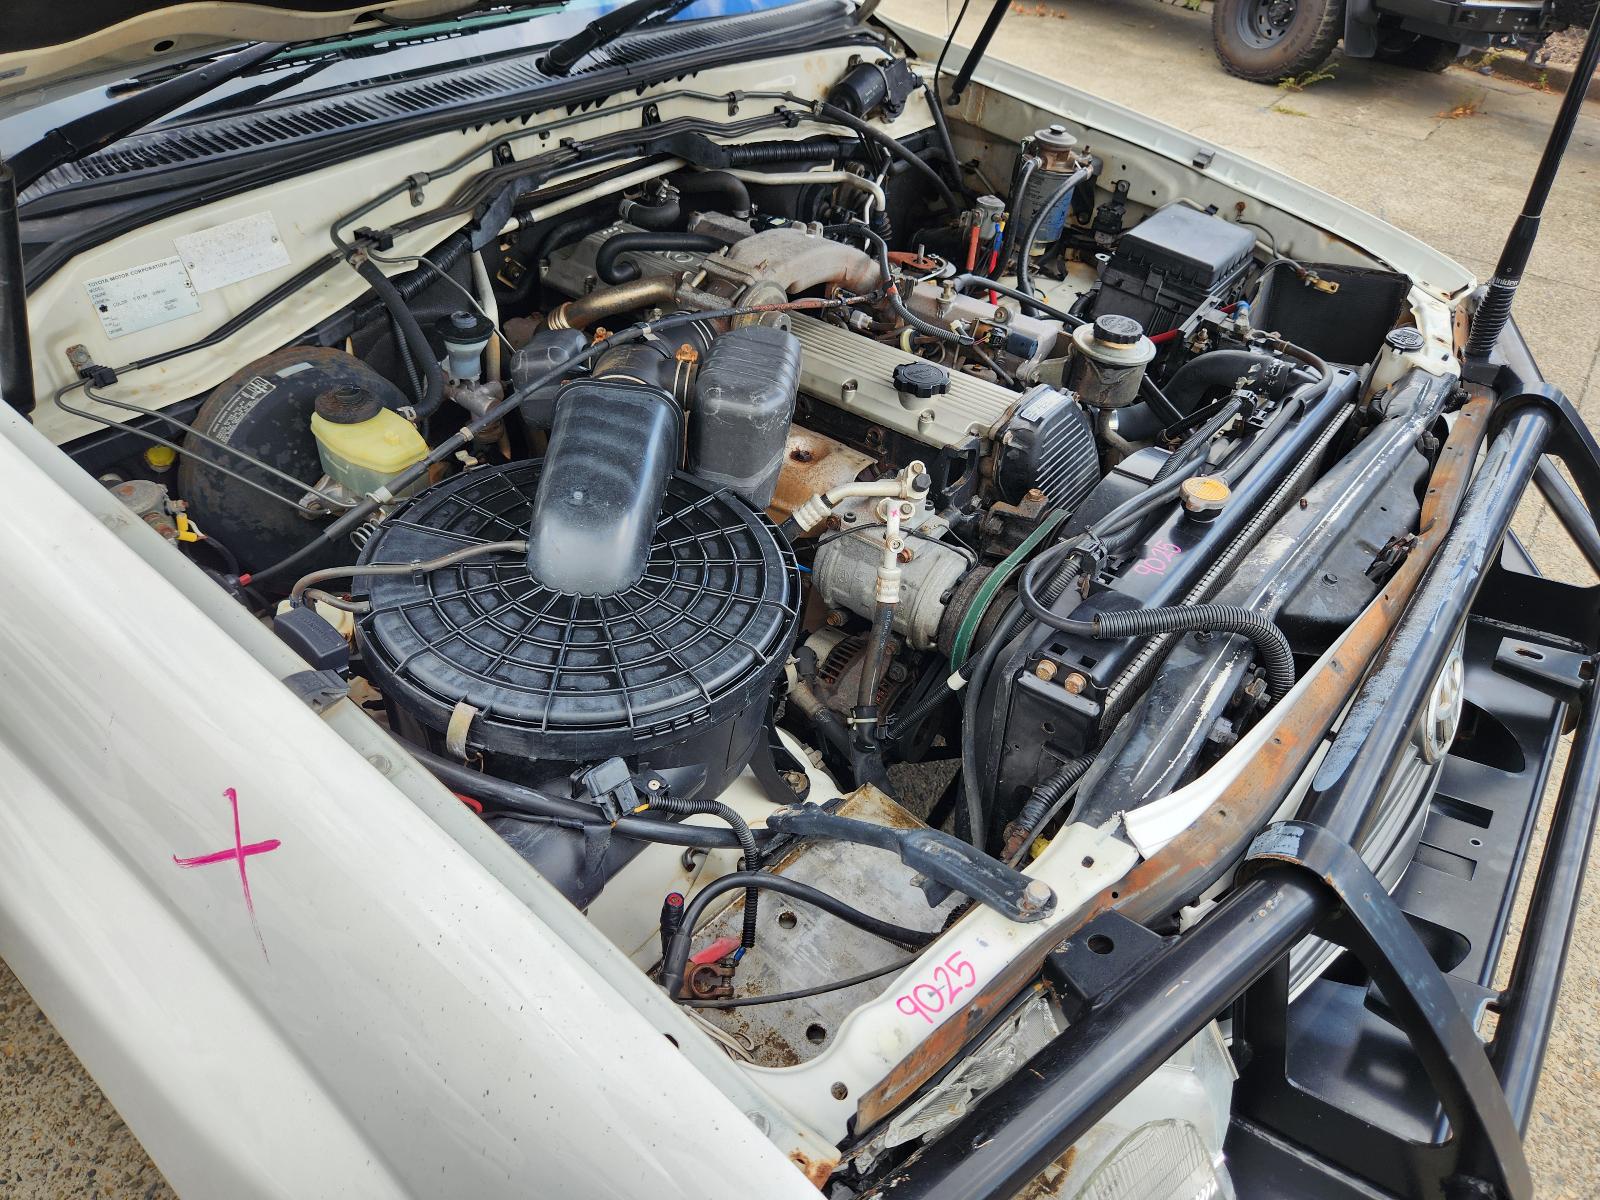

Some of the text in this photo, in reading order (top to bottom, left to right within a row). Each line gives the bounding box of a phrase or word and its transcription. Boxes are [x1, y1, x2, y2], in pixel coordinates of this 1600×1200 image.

[88, 278, 109, 287] TOYOTA
[110, 272, 129, 281] MOTOR
[130, 262, 167, 275] CORPORATION
[1134, 540, 1182, 575] 9025
[896, 950, 976, 1024] 9025
